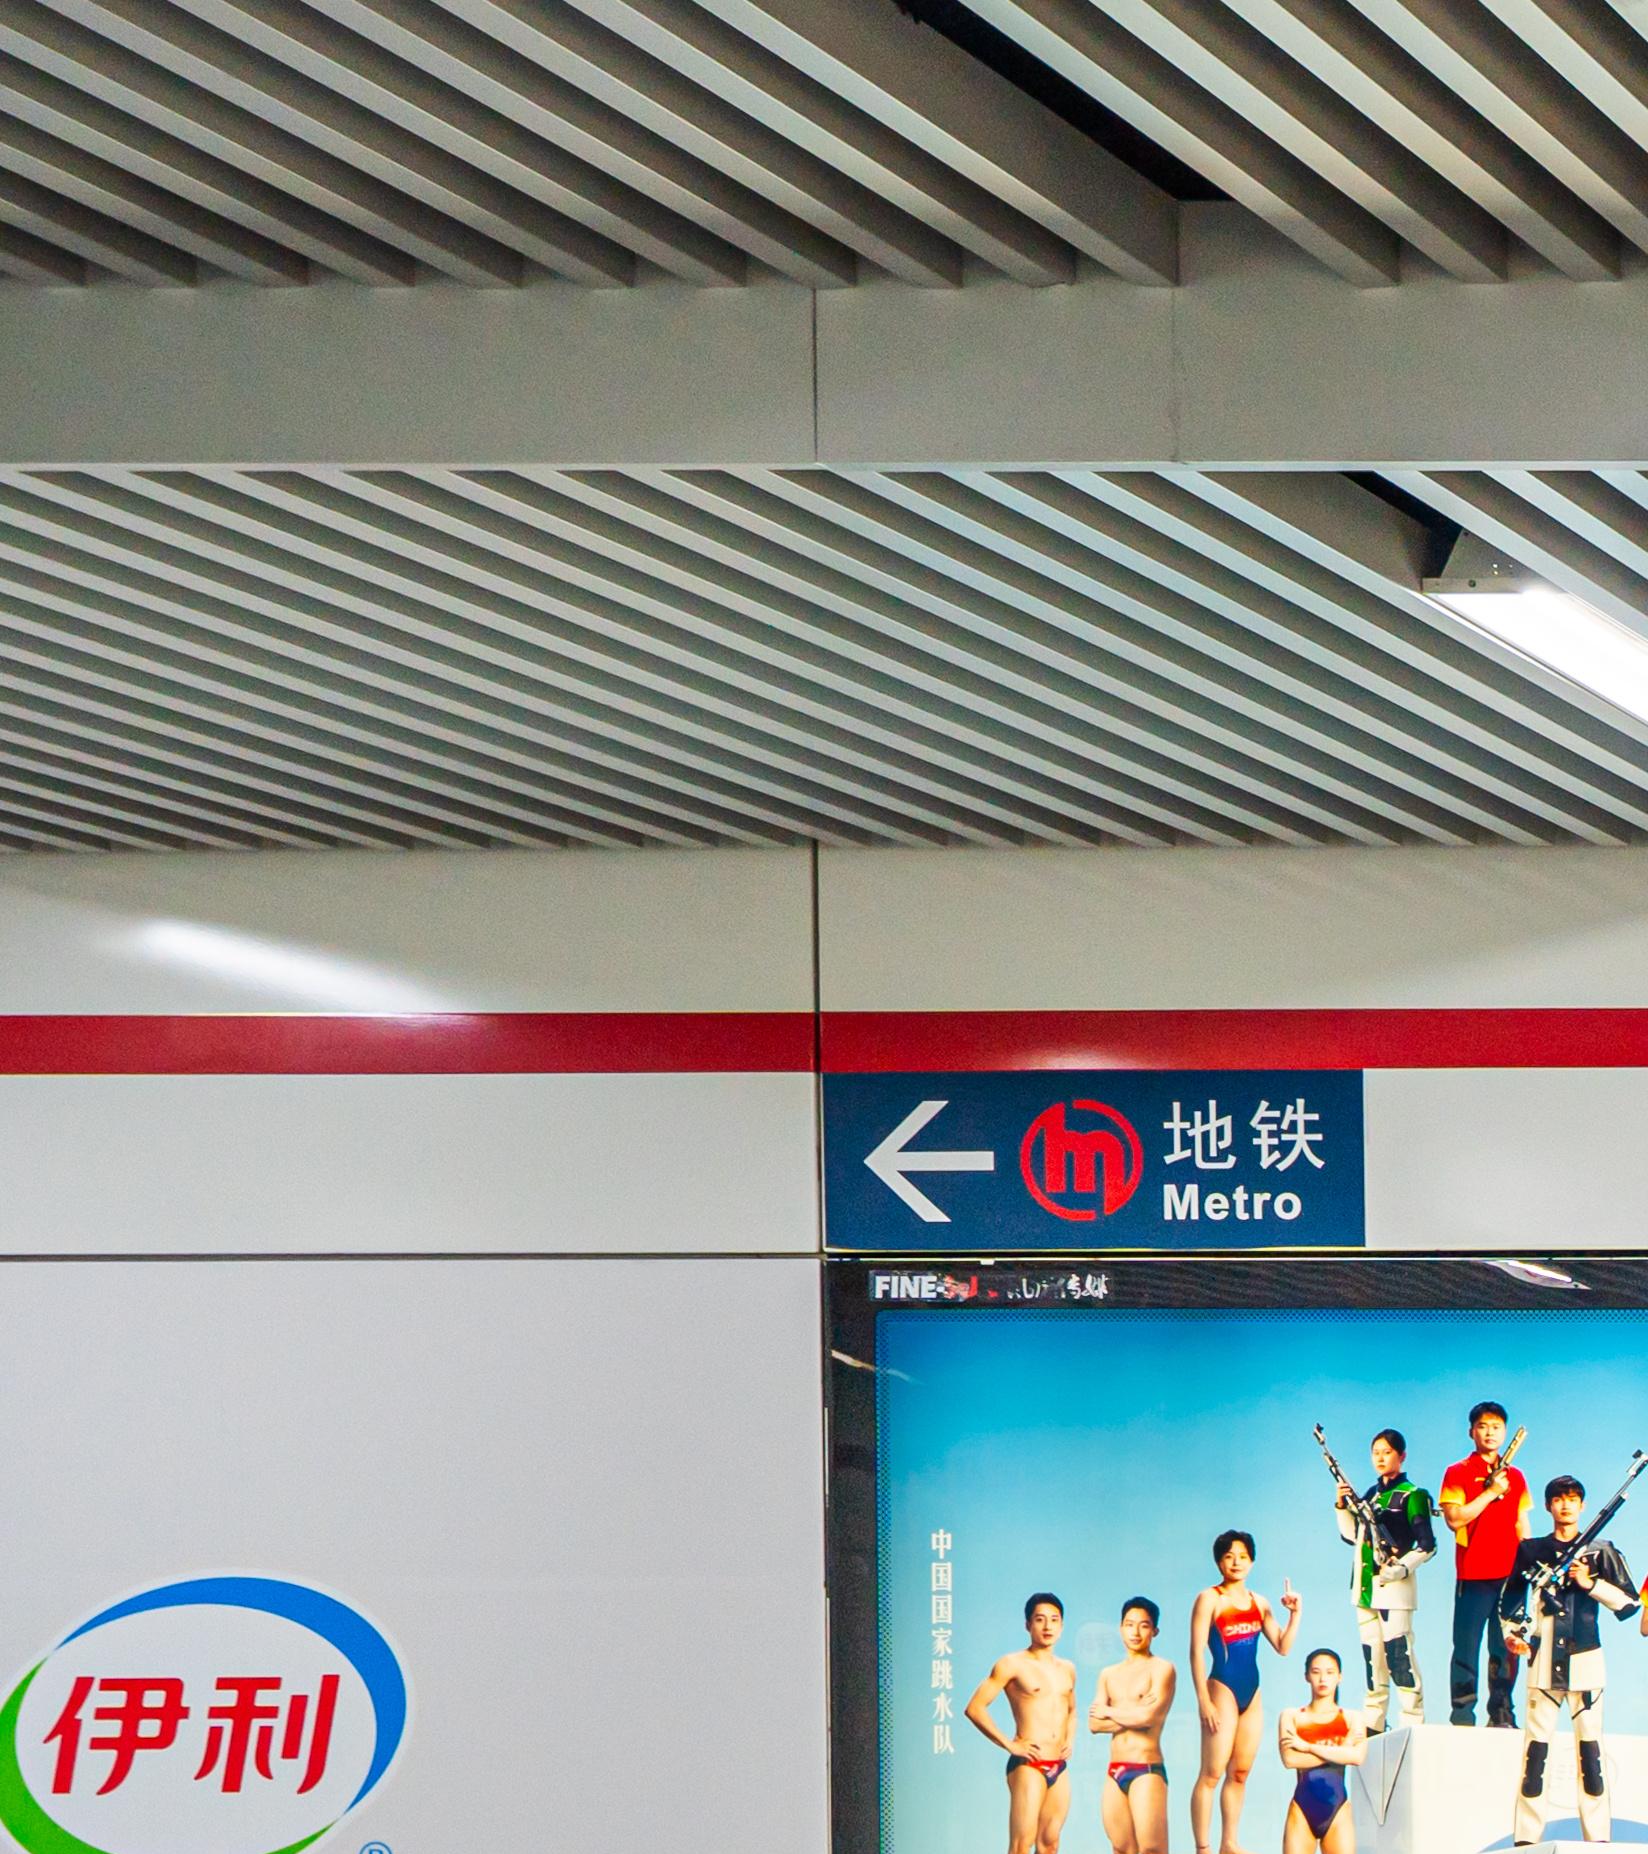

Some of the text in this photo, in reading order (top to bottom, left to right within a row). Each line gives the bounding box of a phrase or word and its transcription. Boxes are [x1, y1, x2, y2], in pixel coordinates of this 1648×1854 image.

[1164, 1098, 1326, 1173] 地铁
[1163, 1184, 1303, 1222] Metro
[930, 1528, 954, 1755] 中国国家跳水队
[43, 1674, 341, 1796] 伊利
